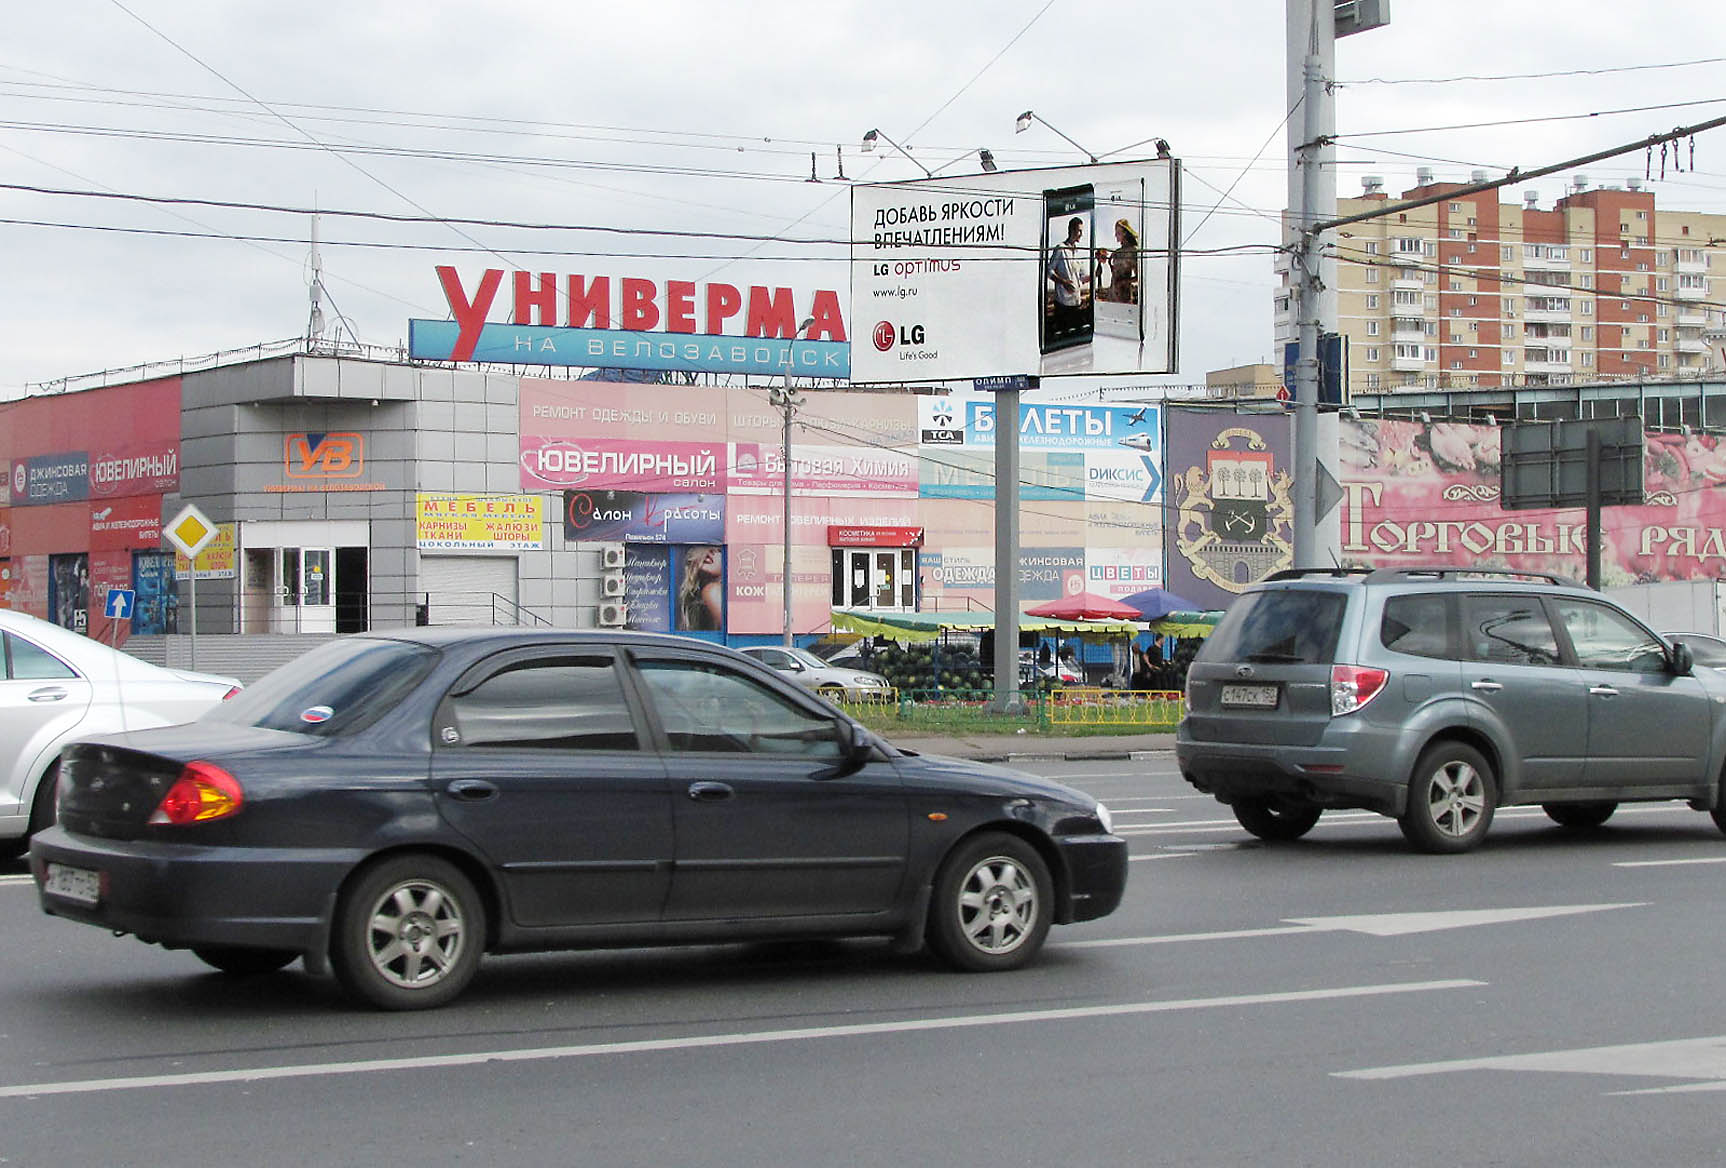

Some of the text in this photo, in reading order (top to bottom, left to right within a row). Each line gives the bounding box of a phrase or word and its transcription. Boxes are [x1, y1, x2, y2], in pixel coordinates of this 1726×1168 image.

[874, 198, 1014, 230] ДОБАВЬ ЯРКОСТИ
[874, 224, 1005, 250] ВПЕЧАТЛЕНИЯМ!
[873, 263, 889, 277] LG
[873, 286, 918, 299] www.lg.ru
[435, 265, 848, 362] УНИВЕРМА
[900, 325, 926, 346] LG
[515, 335, 849, 368] НА ВЕЛОЗАВОДСК
[899, 350, 938, 361] Life's Good
[533, 406, 716, 425] РЕМОНТ ОДЕЖДЫ И ОБУВИ
[974, 406, 1111, 436] БЛЕТЫ
[30, 464, 87, 481] ДЖИНСОВАЯ
[95, 448, 177, 483] ЮВЕЛИРНЫЙ
[537, 449, 716, 476] ЮВЕЛИРНЫЙ
[850, 457, 909, 477] Химия
[424, 501, 536, 513] МЕБЕЛЬ
[569, 494, 632, 529] Салон
[486, 523, 538, 531] ЖАЛЮЗИ
[736, 514, 782, 525] РЕМОНТ
[424, 531, 530, 541] ТКАНИ ШТОРЫ
[1638, 524, 1726, 563] ряд
[1091, 566, 1158, 580] ЦВЕТЫ
